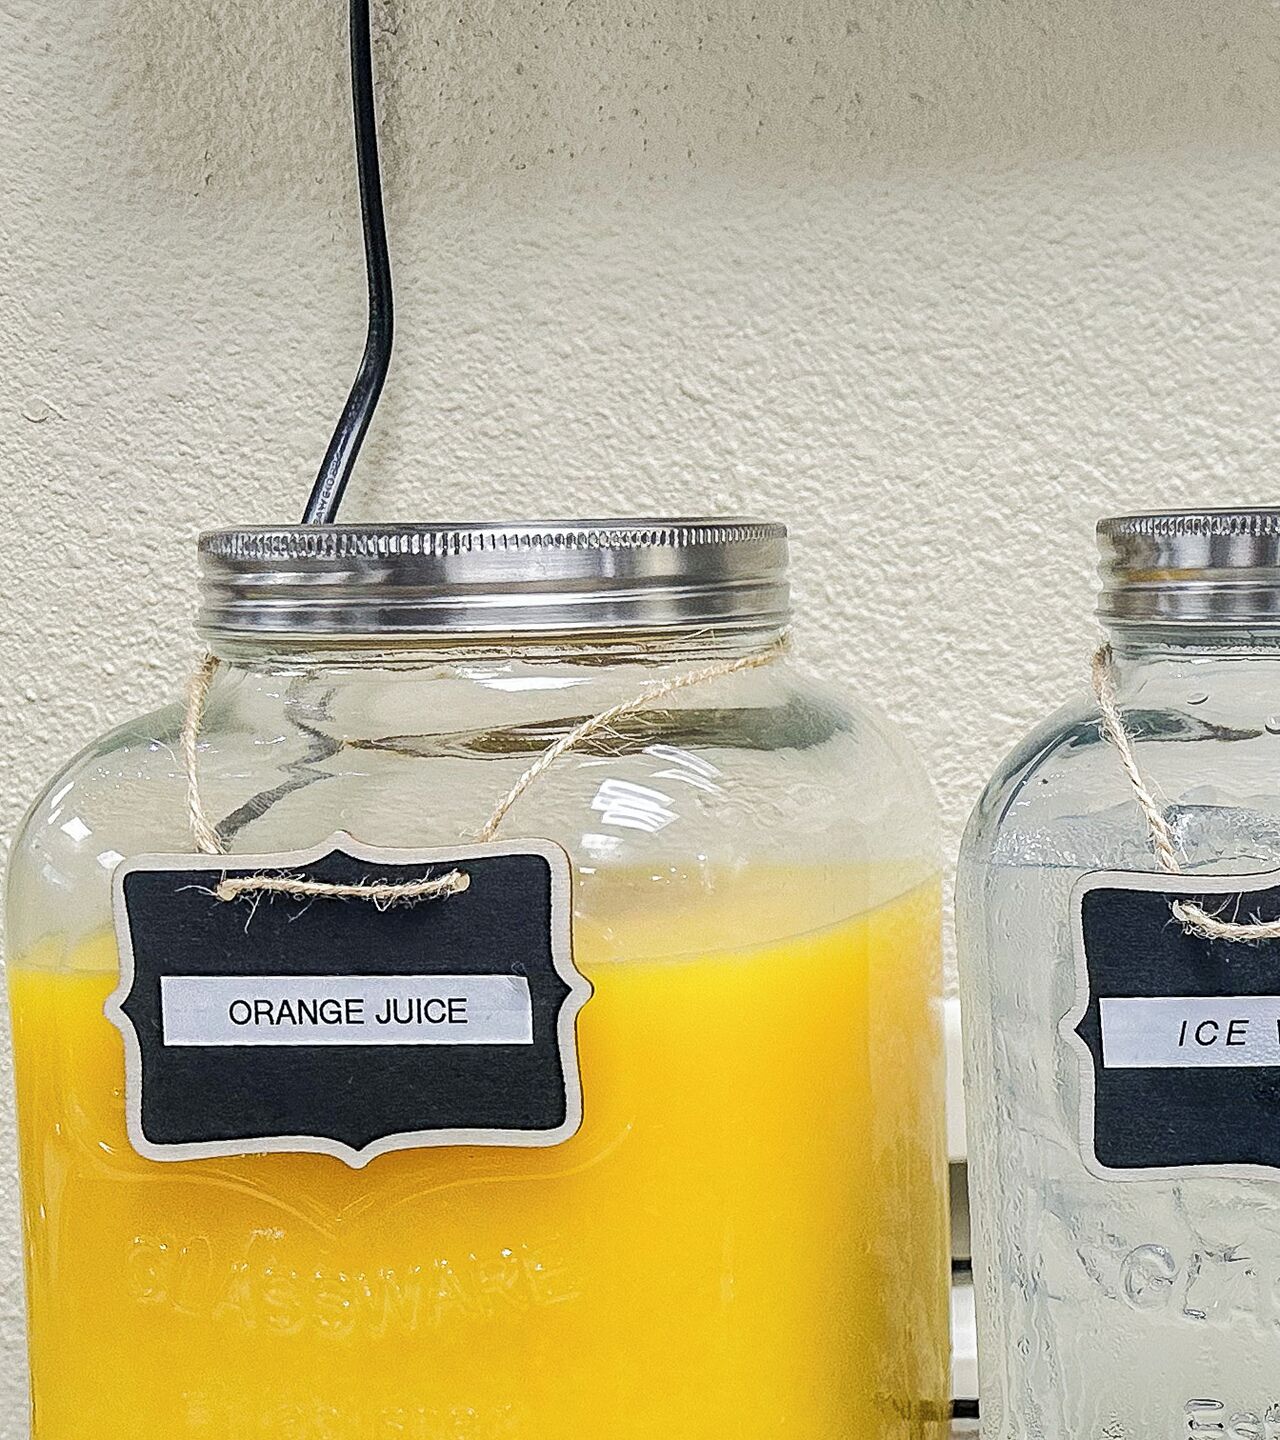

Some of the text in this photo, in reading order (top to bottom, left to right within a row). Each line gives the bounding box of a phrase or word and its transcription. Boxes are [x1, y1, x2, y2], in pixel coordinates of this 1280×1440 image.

[229, 997, 469, 1027] ORANGE JUICE
[1178, 1018, 1250, 1048] ICE
